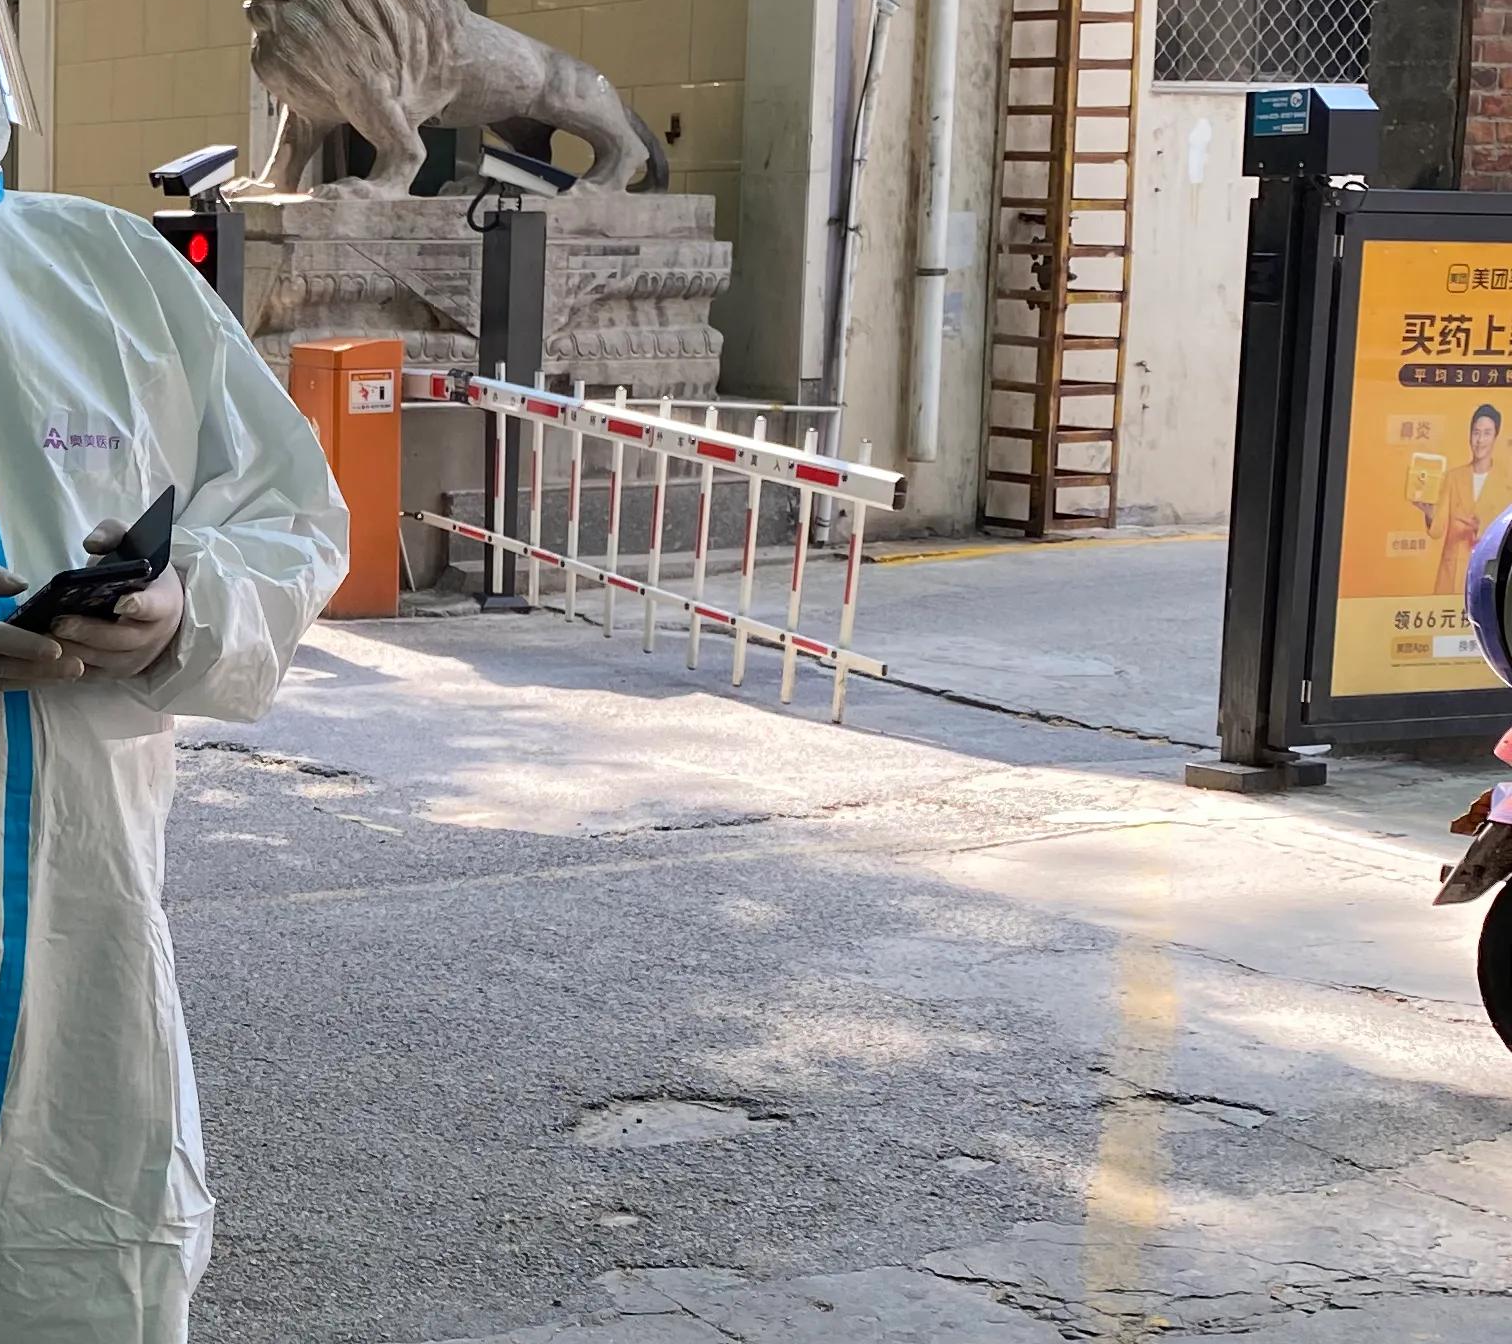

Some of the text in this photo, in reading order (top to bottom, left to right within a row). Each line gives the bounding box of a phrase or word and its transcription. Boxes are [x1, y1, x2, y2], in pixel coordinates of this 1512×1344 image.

[1471, 268, 1512, 291] 美团
[1400, 314, 1512, 357] 买药上
[69, 433, 121, 450] 奥美医疗
